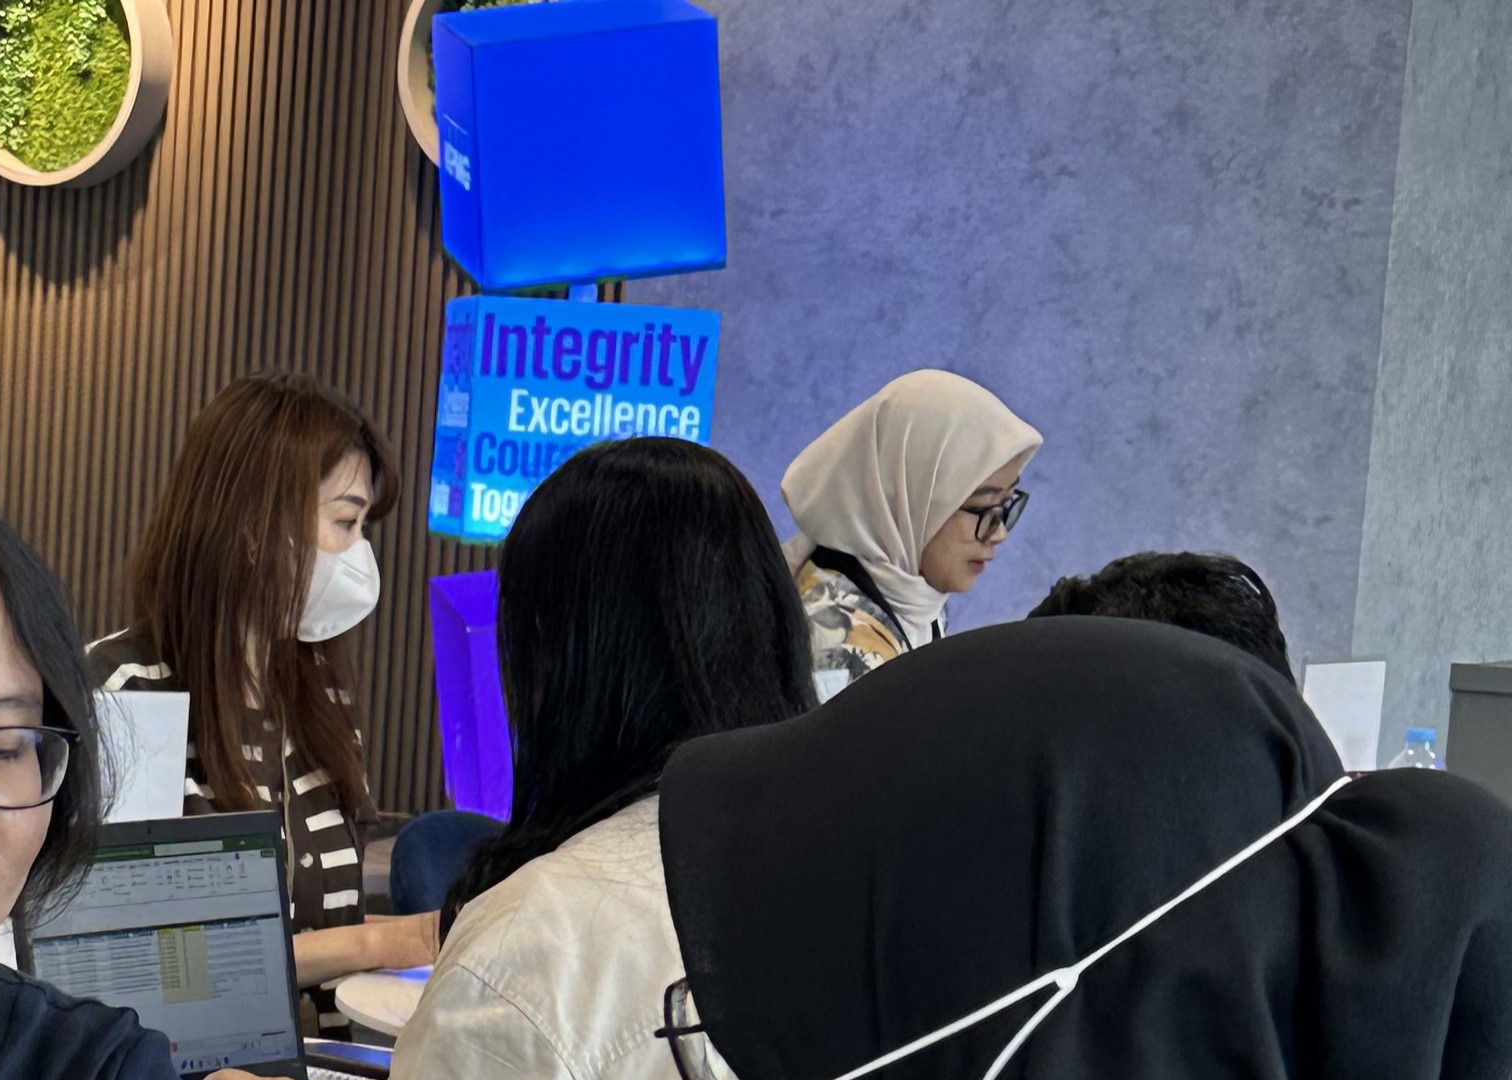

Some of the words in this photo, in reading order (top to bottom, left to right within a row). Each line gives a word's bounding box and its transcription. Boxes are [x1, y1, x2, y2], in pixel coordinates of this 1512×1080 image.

[479, 313, 709, 397] Integrity
[508, 388, 701, 440] Excellence
[470, 481, 524, 528] Tog
